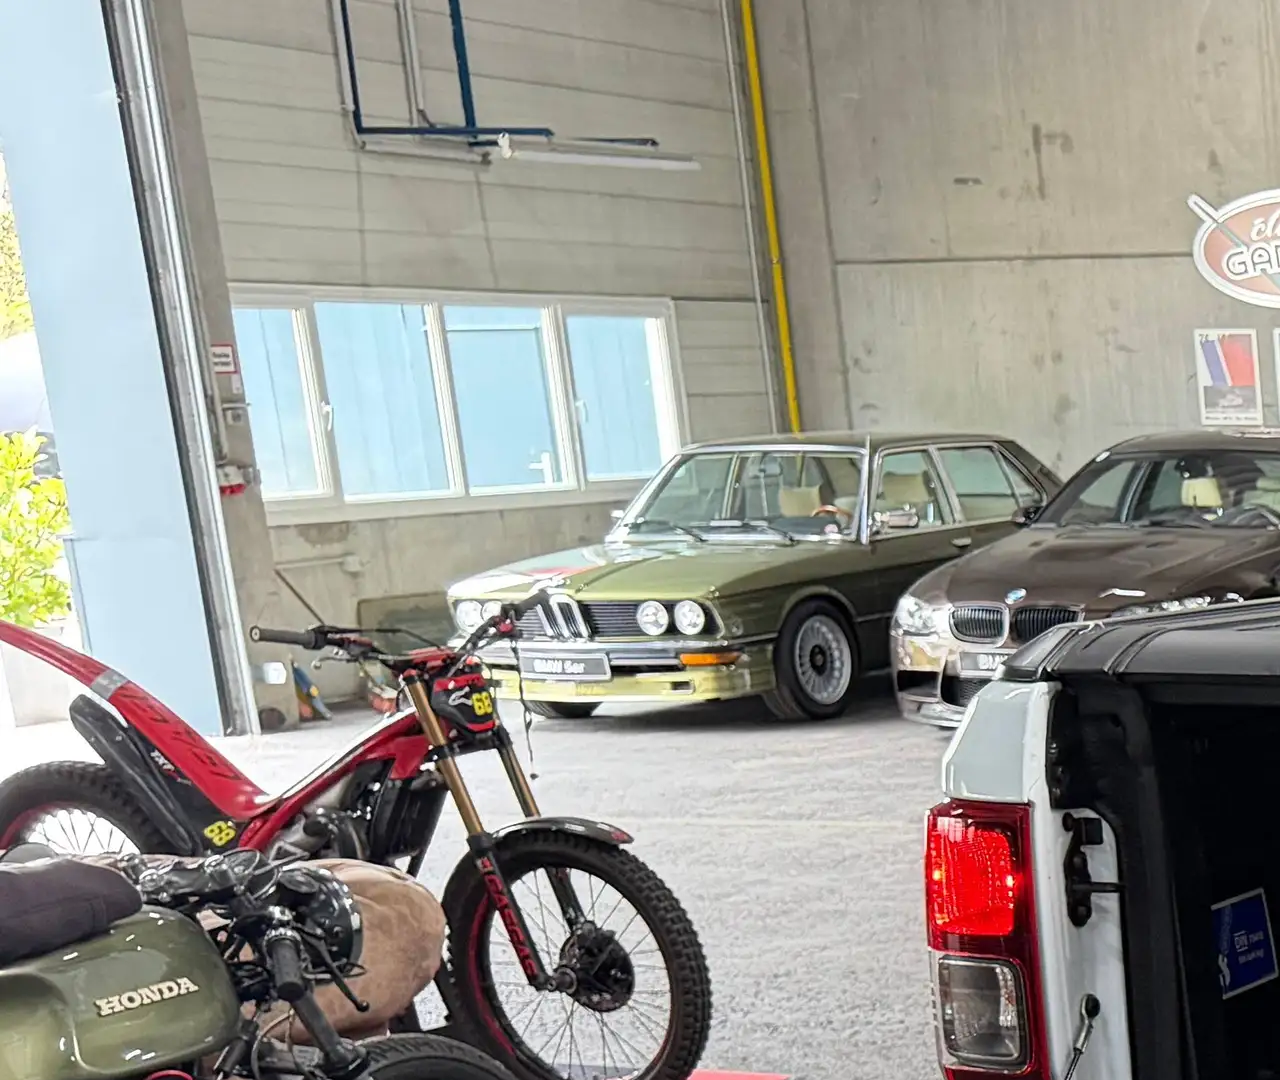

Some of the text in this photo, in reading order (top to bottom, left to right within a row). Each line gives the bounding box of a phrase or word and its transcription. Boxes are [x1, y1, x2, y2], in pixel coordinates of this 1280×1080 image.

[471, 691, 493, 716] 68
[204, 821, 236, 847] 68
[94, 976, 199, 1017] HONDA
